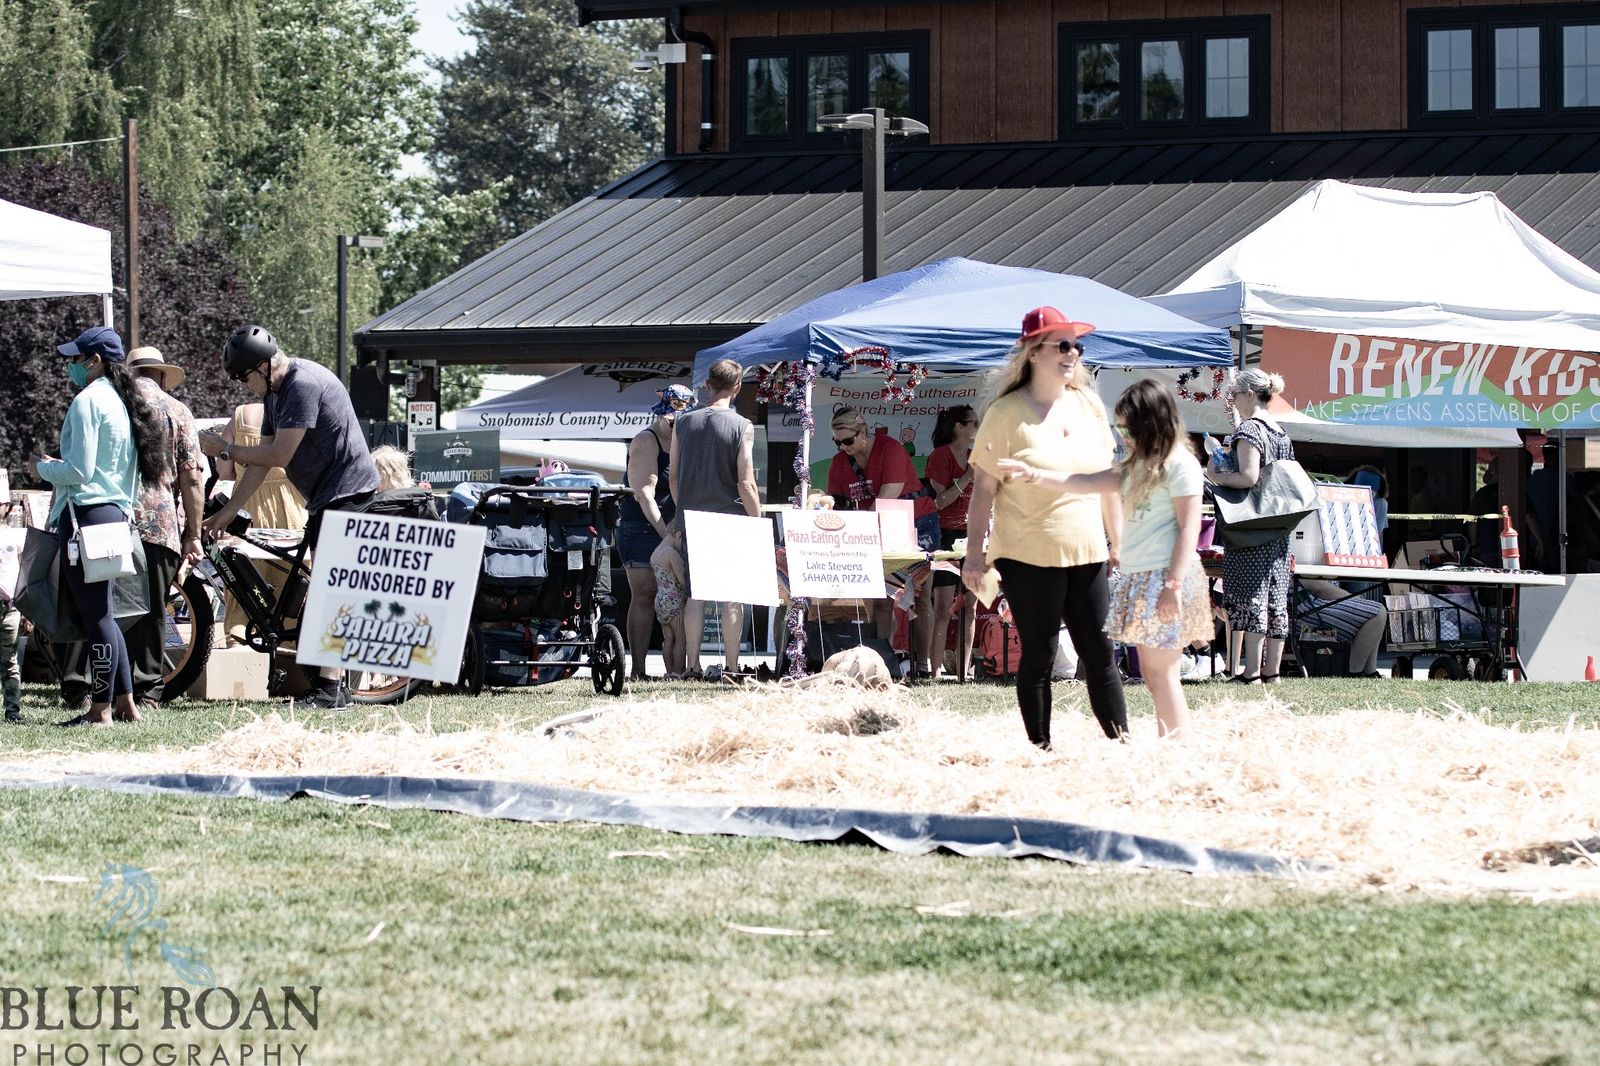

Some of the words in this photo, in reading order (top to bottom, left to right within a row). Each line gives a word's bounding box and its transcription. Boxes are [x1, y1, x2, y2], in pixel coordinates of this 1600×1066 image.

[1329, 334, 1498, 399] RENEW
[829, 386, 881, 400] Ebene
[914, 388, 977, 399] utheran
[479, 412, 554, 427] Snohomish
[559, 412, 610, 430] County
[613, 411, 656, 427] Sherif
[1351, 402, 1432, 422] STEVENS
[1440, 402, 1544, 422] ASSEMBLY
[1552, 402, 1581, 422] OF
[344, 518, 390, 541] PIZZA
[396, 523, 456, 549] EATING
[787, 529, 810, 544] Pizza
[811, 530, 841, 549] Eating
[842, 532, 879, 545] Contest
[357, 545, 433, 572] CONTEST
[806, 561, 827, 571] Lake
[828, 561, 863, 571] Stevens
[328, 567, 427, 597] SPONSORED
[431, 579, 455, 600] BY
[802, 573, 840, 583] SAHARA
[841, 574, 871, 583] PIZZA
[332, 615, 432, 648] SAHARA
[341, 639, 413, 669] PIZZA
[92, 643, 112, 694] FILA
